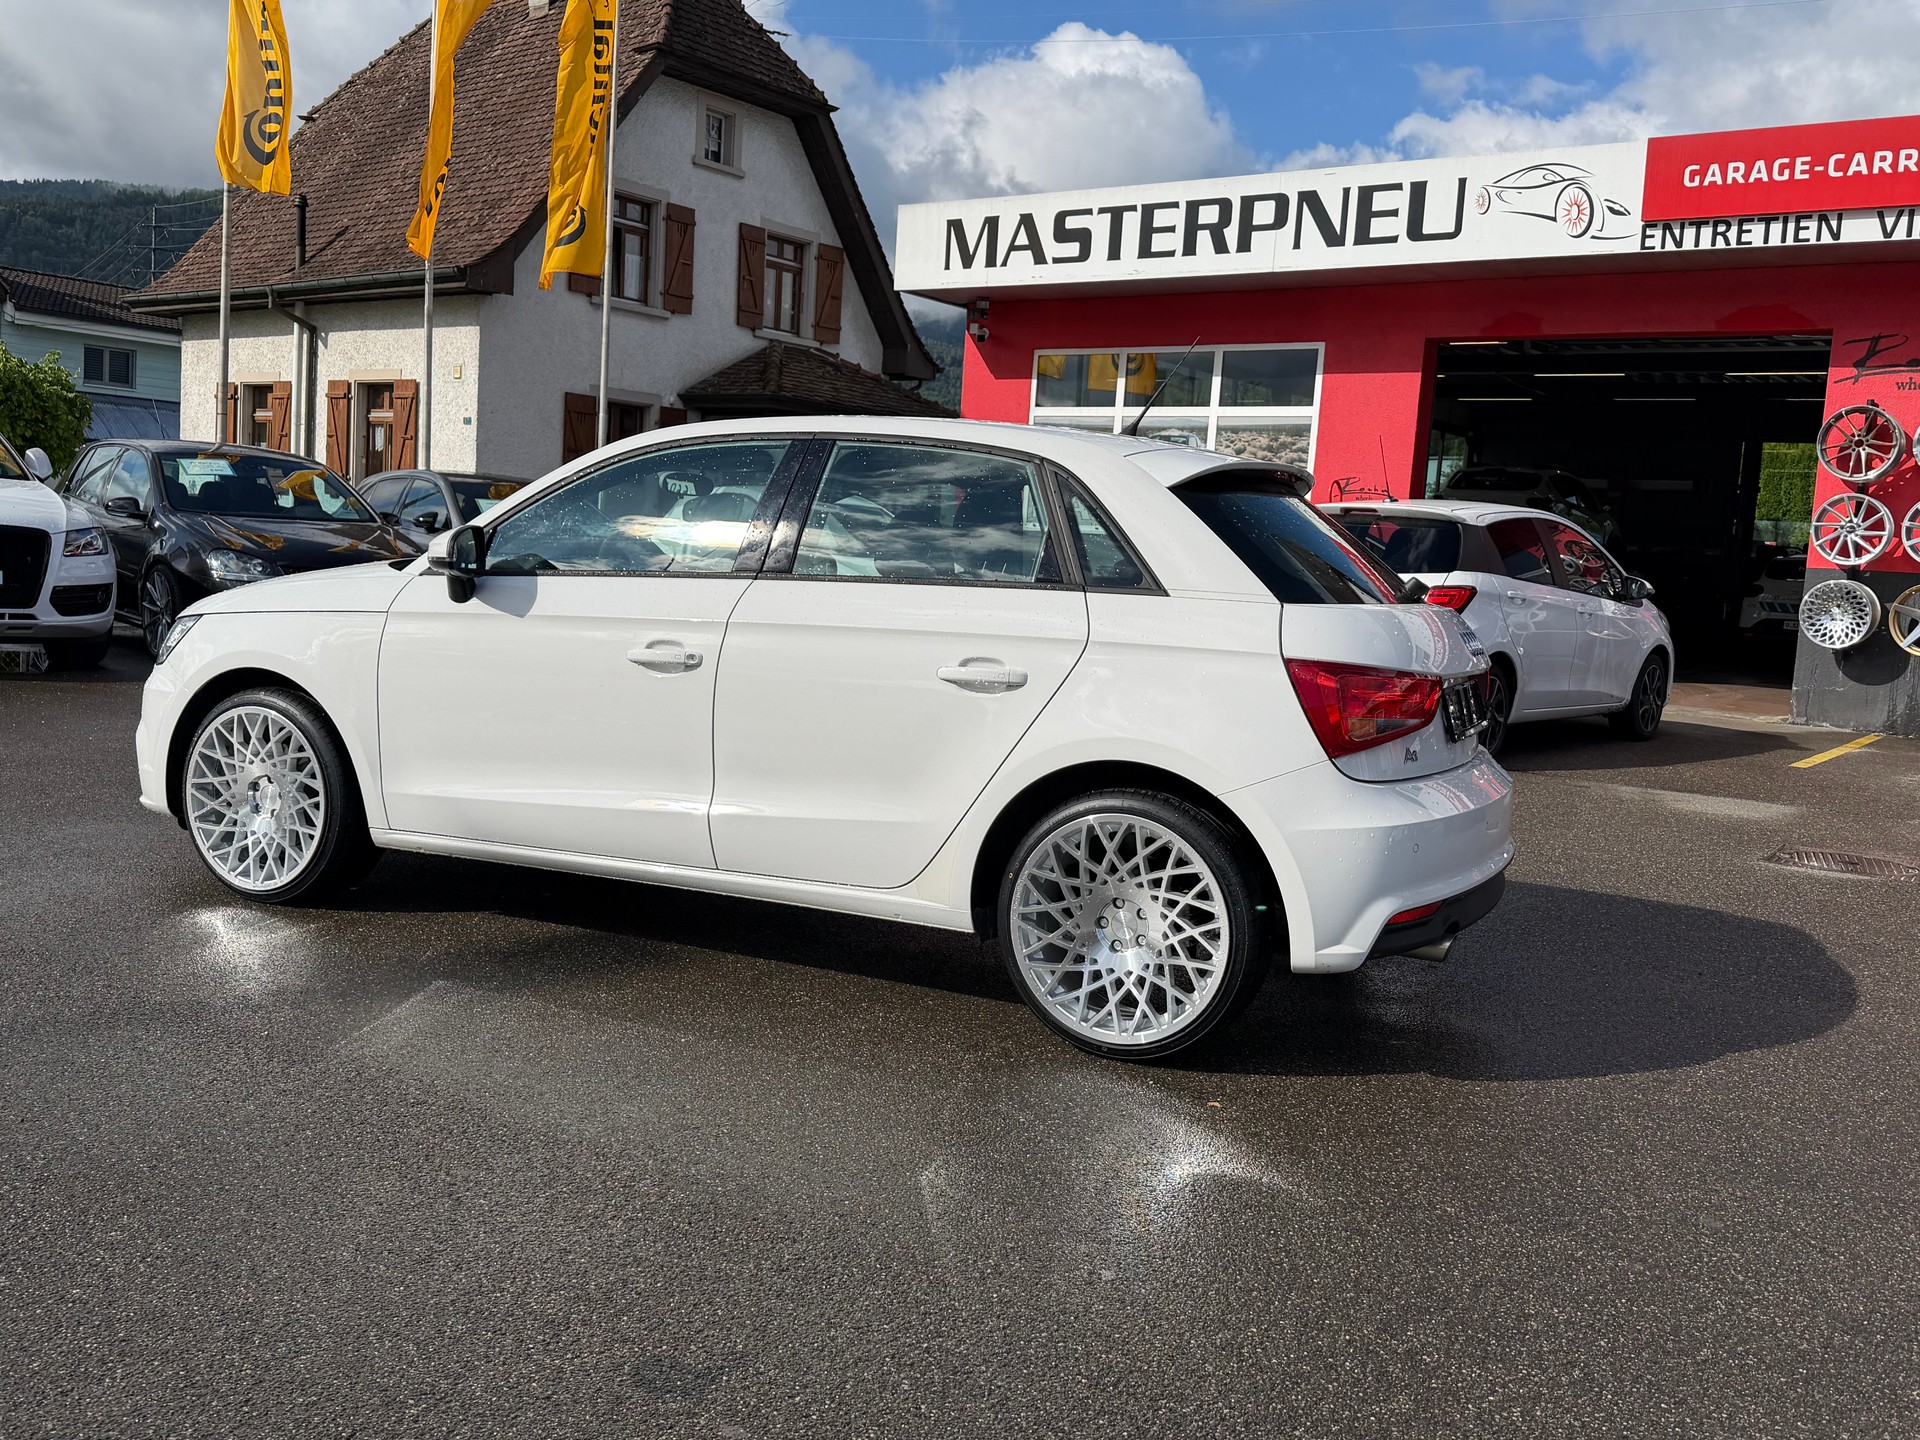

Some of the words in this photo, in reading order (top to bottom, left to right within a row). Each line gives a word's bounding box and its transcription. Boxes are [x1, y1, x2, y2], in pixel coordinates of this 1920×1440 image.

[1683, 147, 1920, 188] GARAGE-CARR
[943, 176, 1467, 271] MASTERPNEU
[1640, 211, 1844, 251] ENTRETIEN
